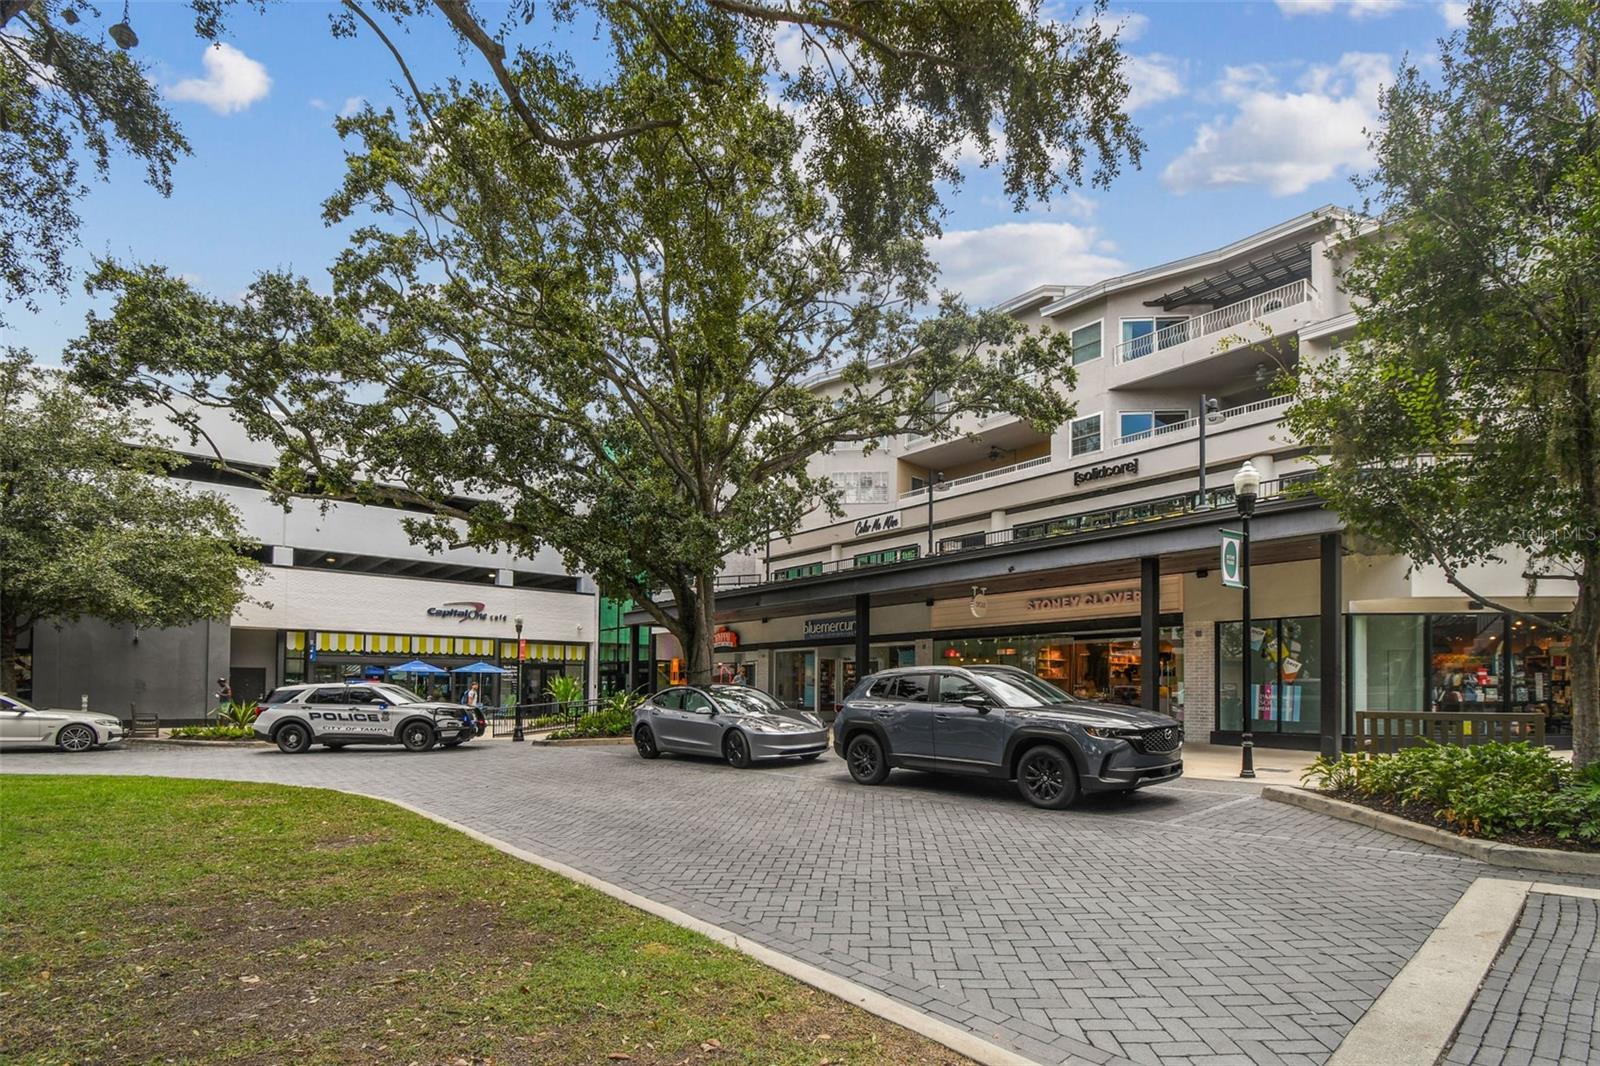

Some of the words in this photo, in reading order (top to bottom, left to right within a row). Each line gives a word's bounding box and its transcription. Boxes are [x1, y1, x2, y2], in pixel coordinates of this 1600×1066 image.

[1027, 595, 1080, 611] STONEY
[1085, 589, 1141, 606] CLOVER
[308, 712, 381, 722] POLICE
[359, 726, 389, 734] TAMPA
